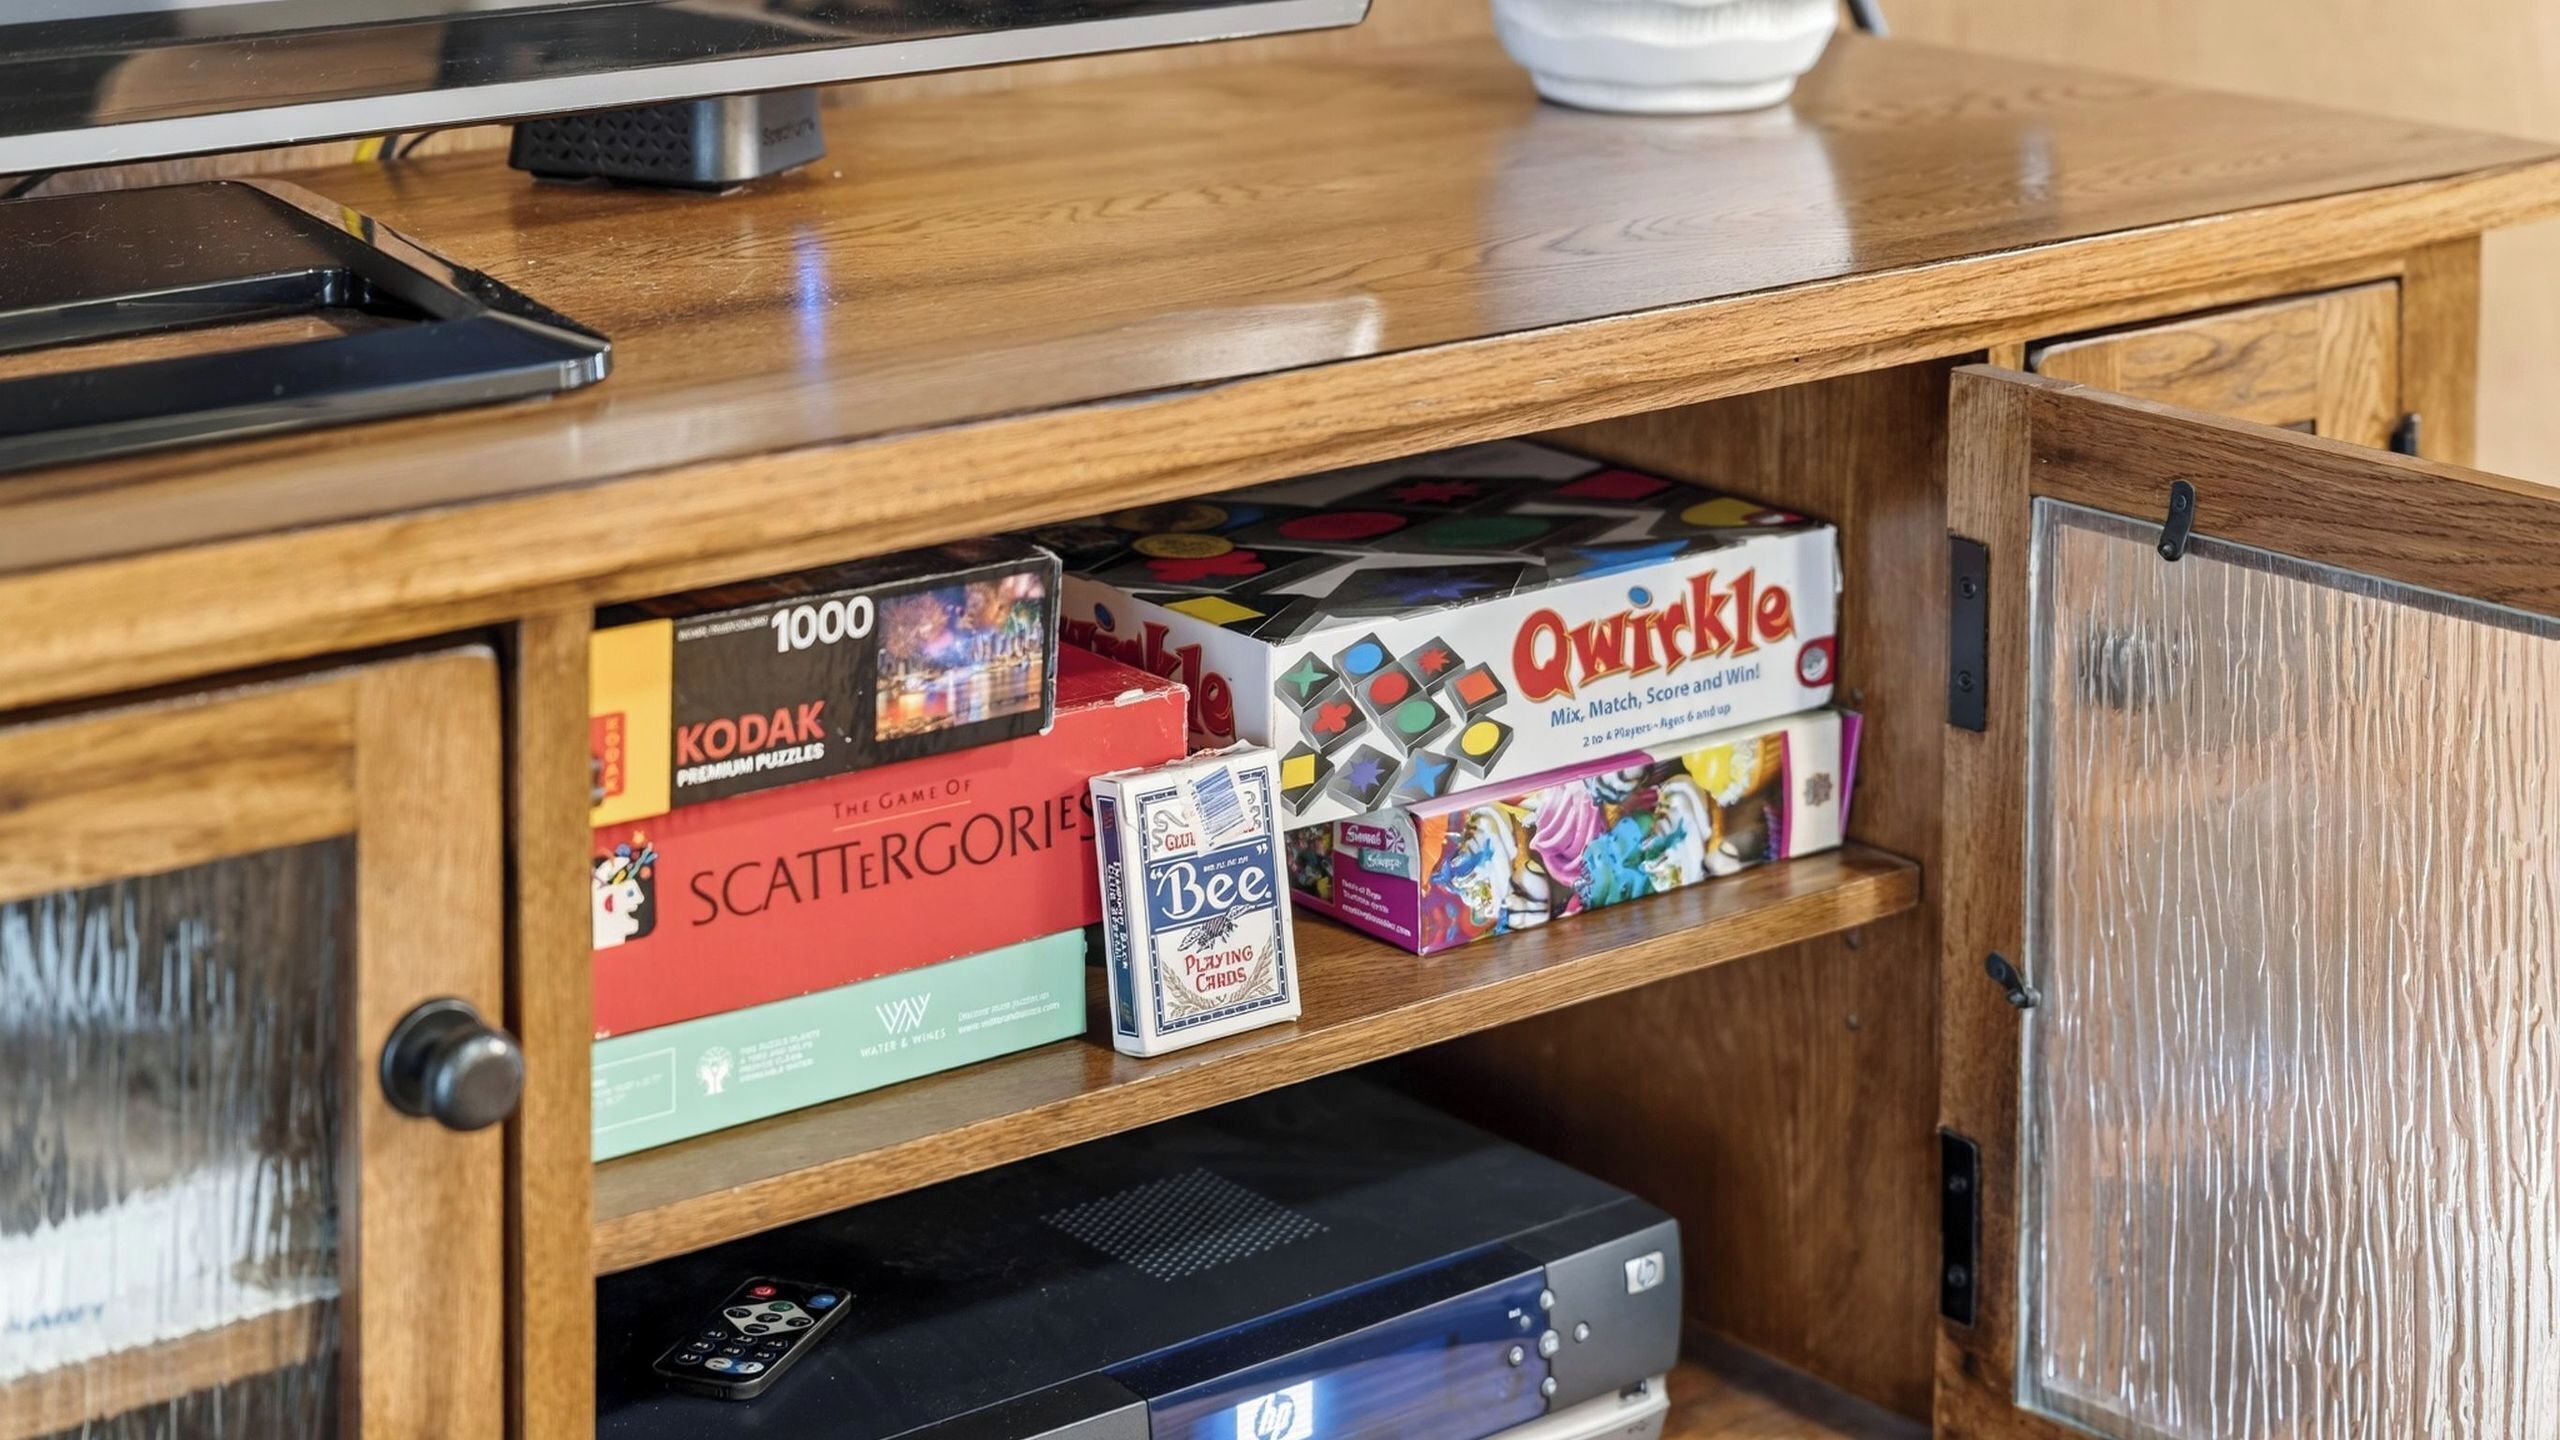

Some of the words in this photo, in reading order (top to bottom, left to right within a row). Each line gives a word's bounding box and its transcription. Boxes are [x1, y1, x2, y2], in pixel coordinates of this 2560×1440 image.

[771, 595, 875, 654] 1000
[1512, 567, 1797, 704] Qwirkle
[1551, 706, 1585, 727] Mix,
[1589, 691, 1642, 719] Match,
[1647, 687, 1690, 705] Score
[1693, 672, 1722, 693] and
[1726, 663, 1760, 687] Win!
[676, 700, 826, 767] KODAK
[1583, 736, 1590, 747] 2
[1592, 736, 1604, 745] to
[1606, 731, 1613, 741] 4
[1614, 724, 1652, 740] Players
[1660, 716, 1685, 730] Ages
[1687, 713, 1694, 722] 6
[1696, 705, 1715, 720] and
[1717, 703, 1731, 716] up
[676, 755, 754, 788] PREMIUM
[755, 742, 825, 772] PUZZLES
[833, 802, 870, 819] THE
[878, 786, 938, 810] GAME
[945, 779, 972, 796] OF
[1185, 945, 1254, 976] PLAYING
[1196, 966, 1247, 993] CARDS
[861, 1041, 897, 1058] WATER
[912, 1027, 946, 1045] WINES
